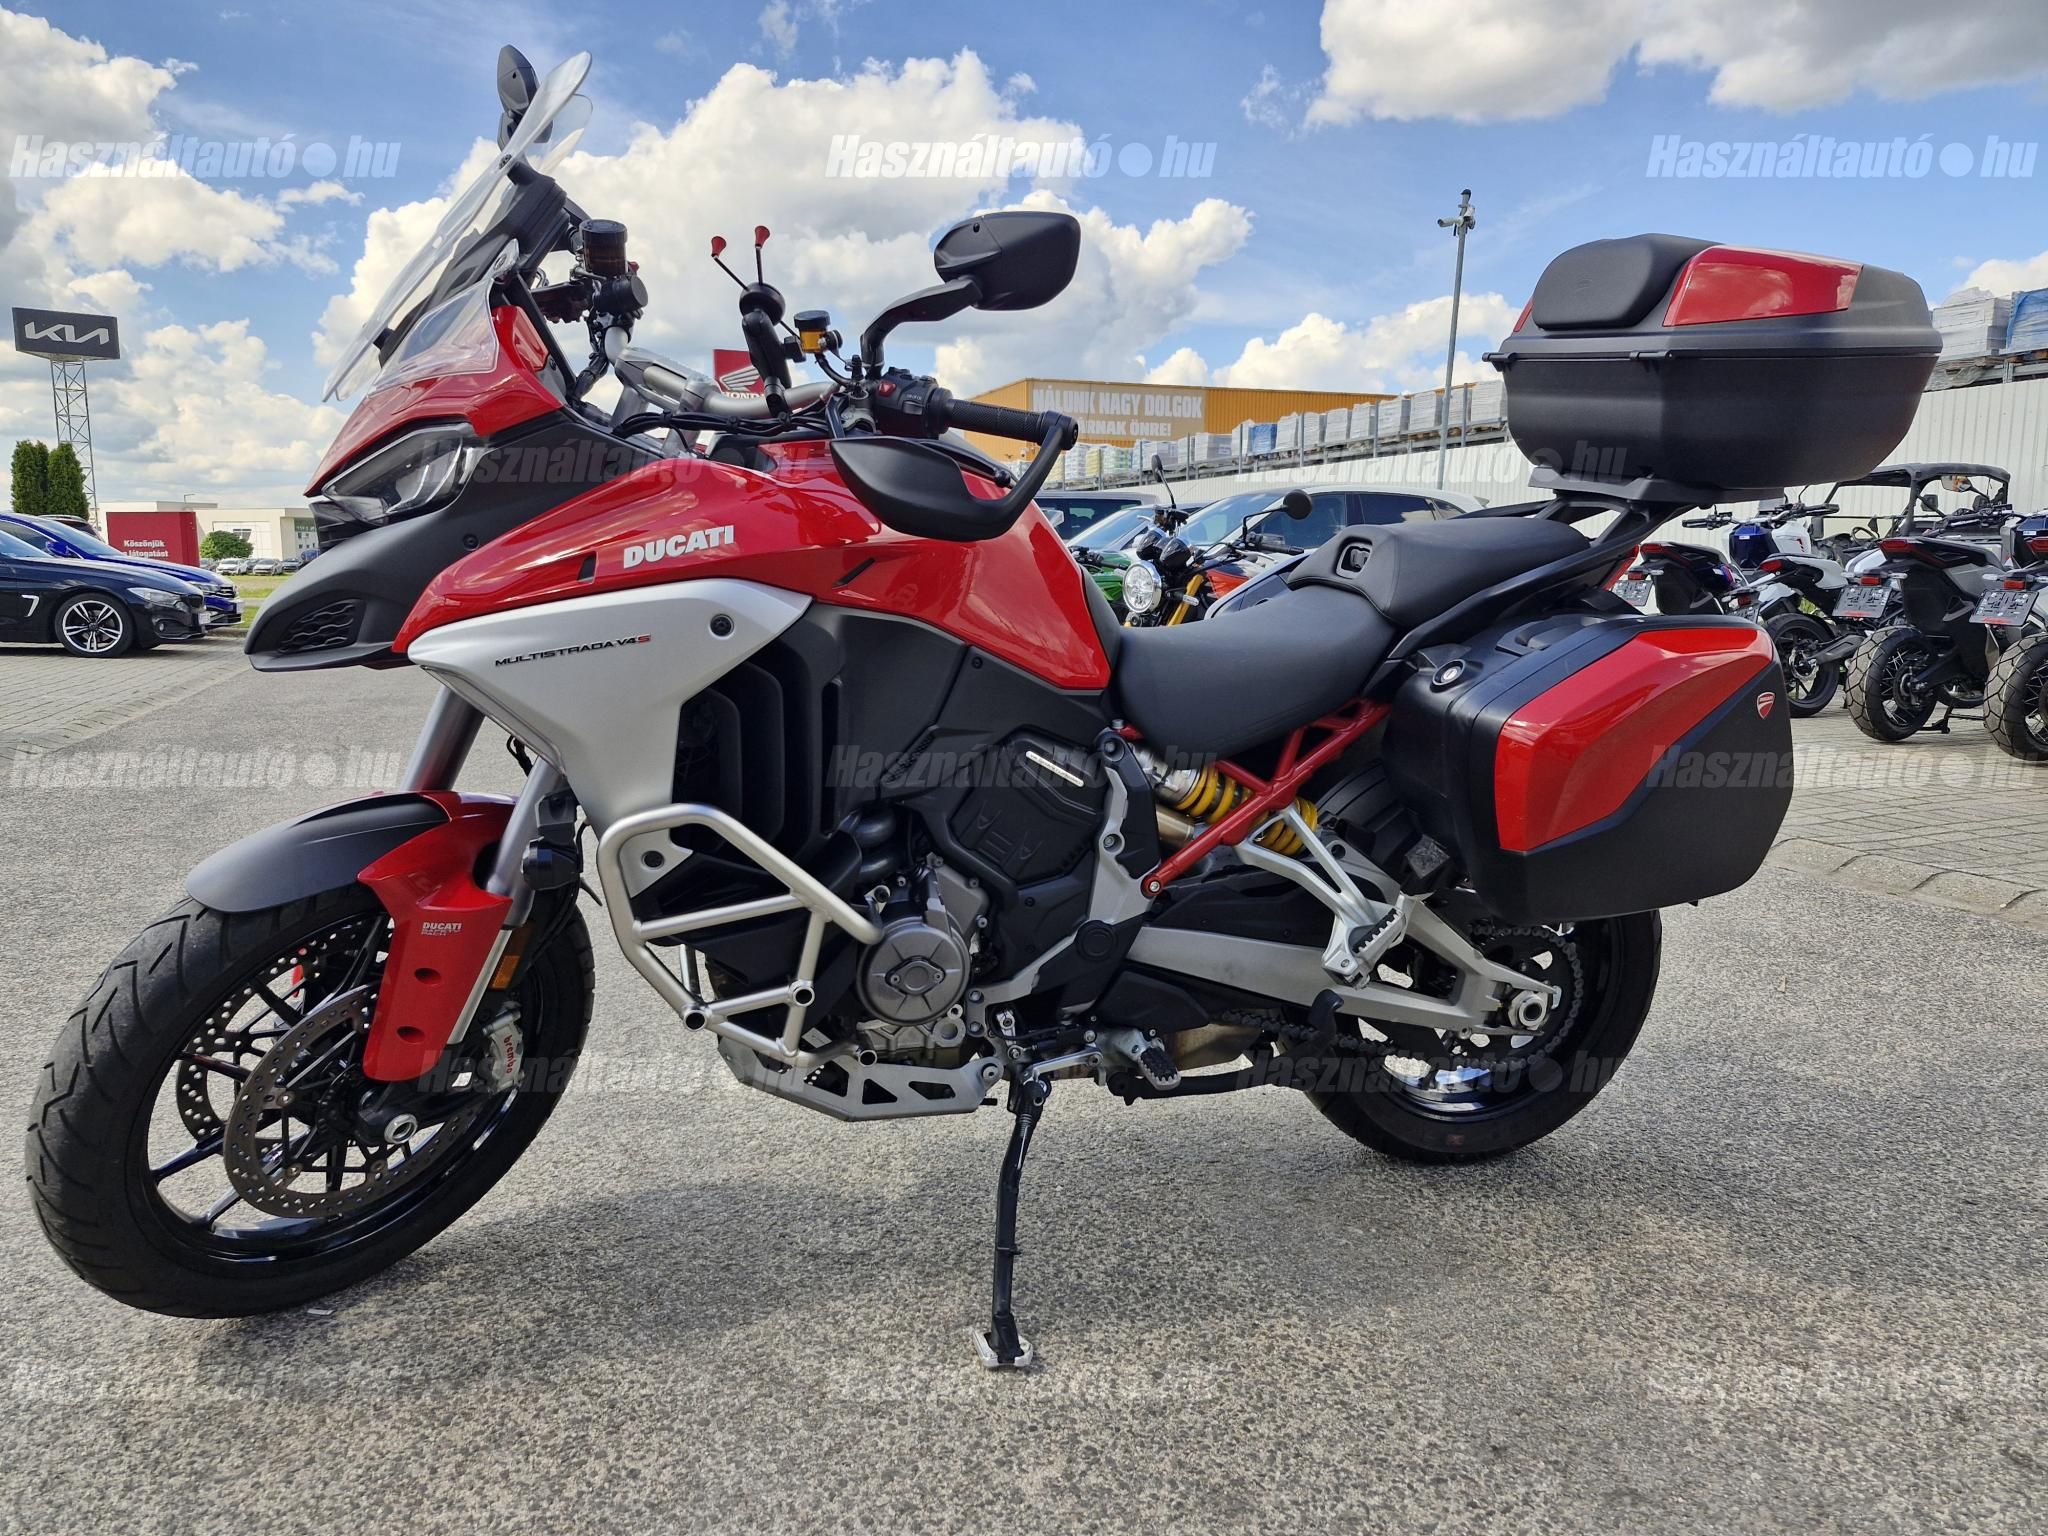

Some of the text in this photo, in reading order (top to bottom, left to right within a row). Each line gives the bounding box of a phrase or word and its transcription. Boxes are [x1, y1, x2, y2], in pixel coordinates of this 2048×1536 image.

[25, 321, 109, 345] KIA
[1099, 391, 1141, 416] NAGY
[1144, 393, 1203, 418] DOLGOK
[1077, 417, 1172, 437] ÁRNAK ÖNRE!
[123, 539, 165, 549] Köszönjük
[623, 525, 735, 569] DUCATI
[494, 641, 614, 667] MULTISTRADA
[423, 921, 463, 930] DUCATI
[503, 1034, 516, 1074] brembo
